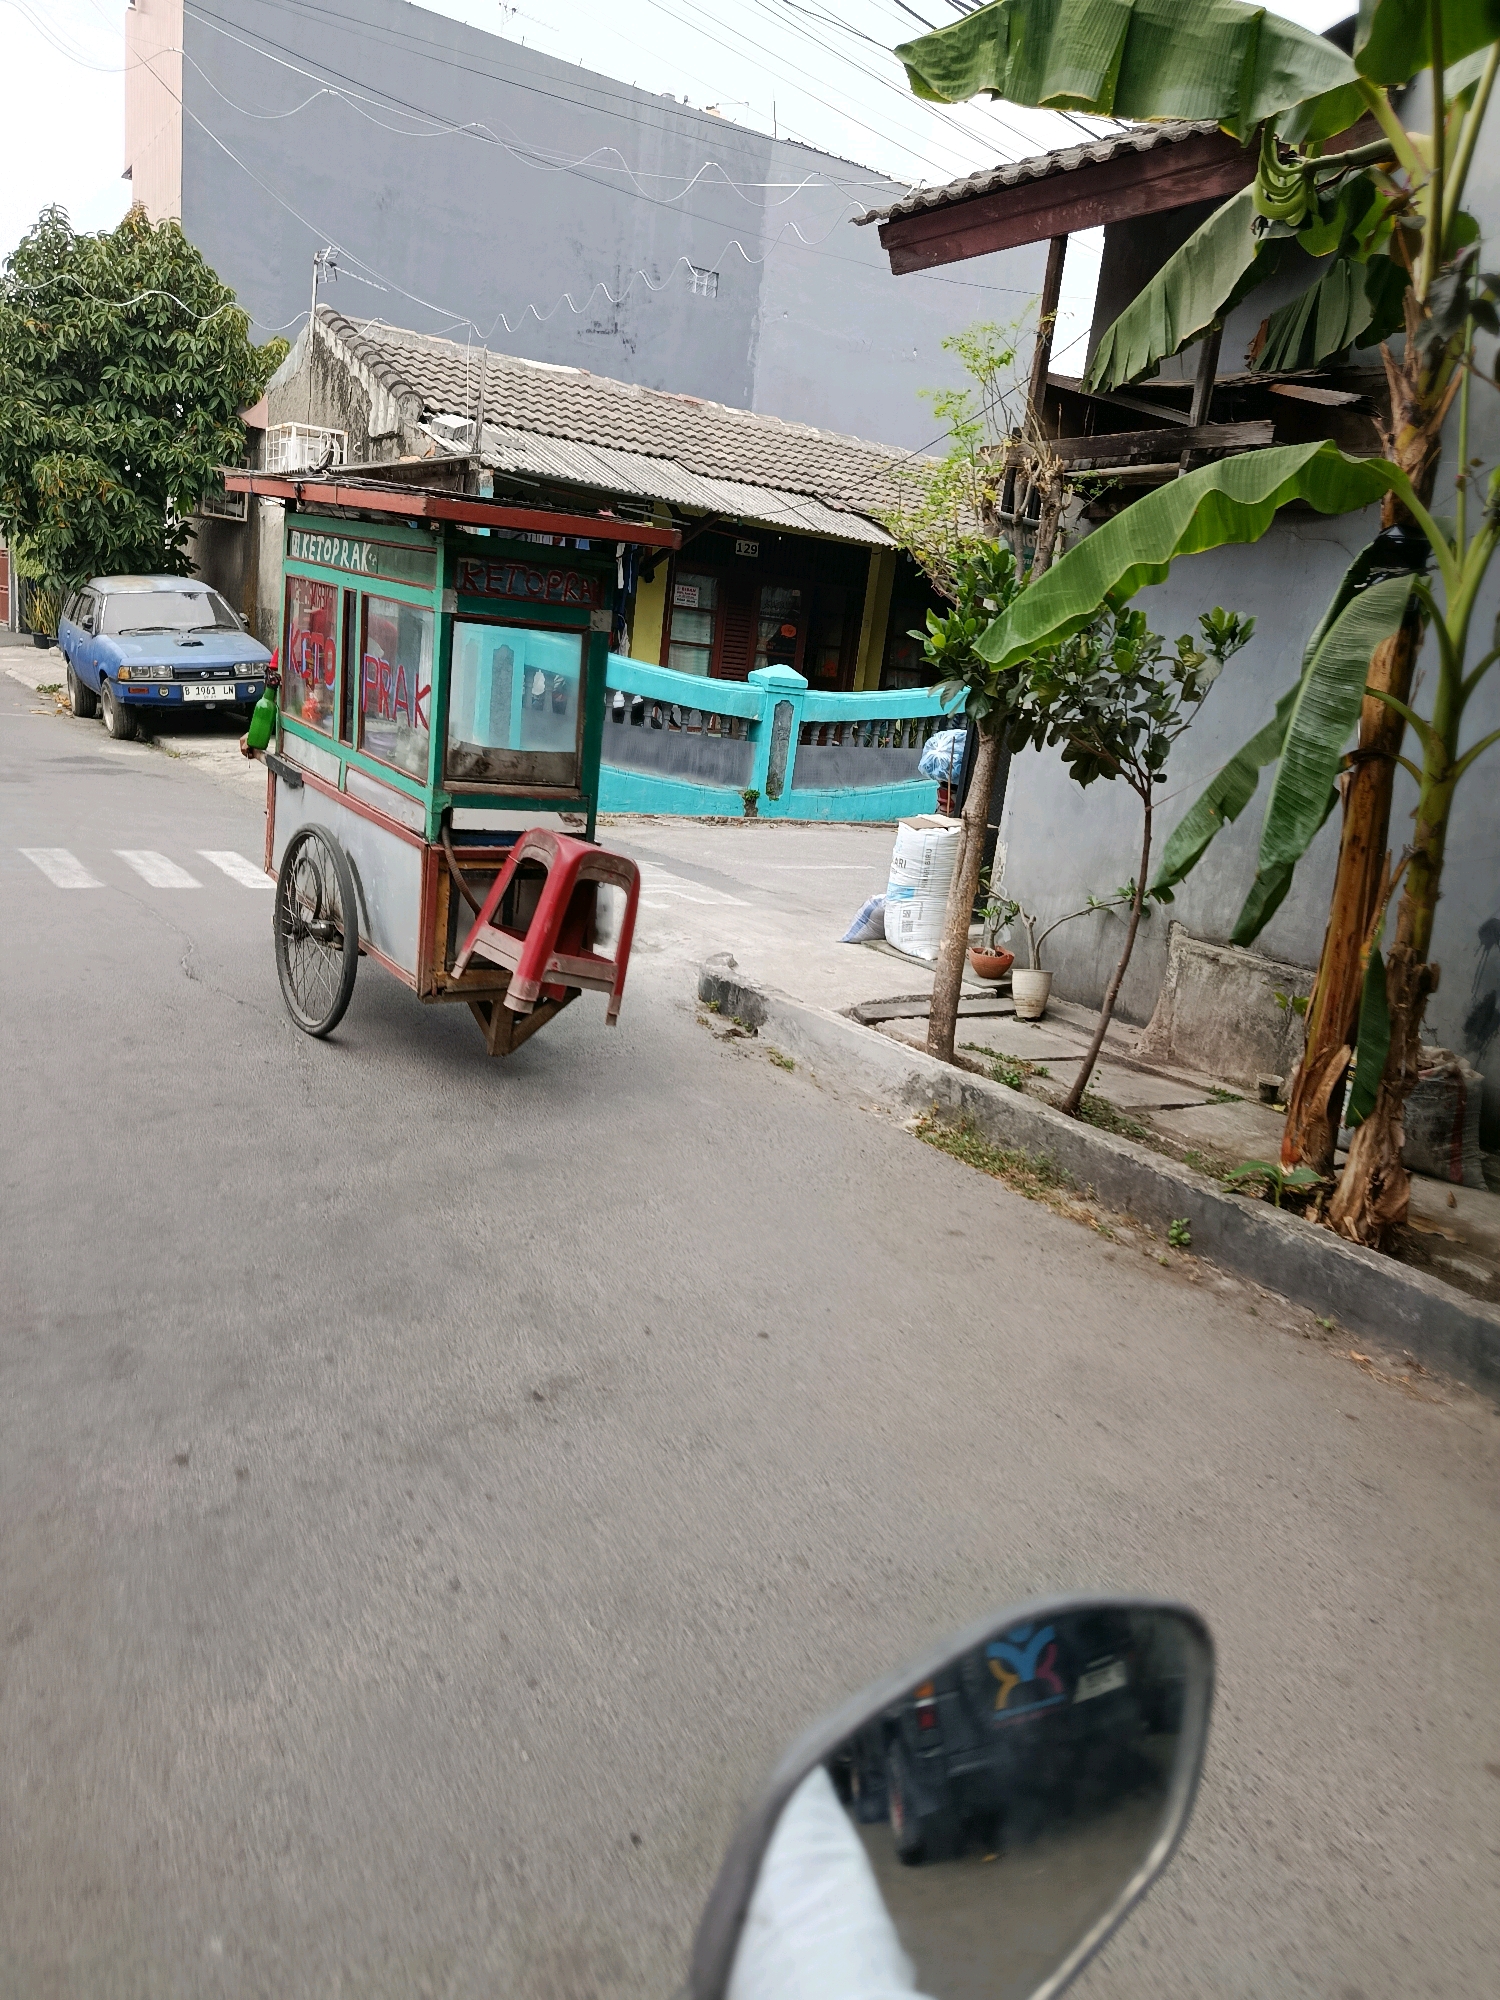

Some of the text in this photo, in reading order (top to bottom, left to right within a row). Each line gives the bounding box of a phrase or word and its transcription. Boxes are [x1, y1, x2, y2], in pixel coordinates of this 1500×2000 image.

[301, 533, 372, 572] KETOPRAK
[736, 542, 758, 555] 129
[184, 686, 191, 696] B
[223, 685, 234, 695] LN
[362, 653, 431, 732] PRAK
